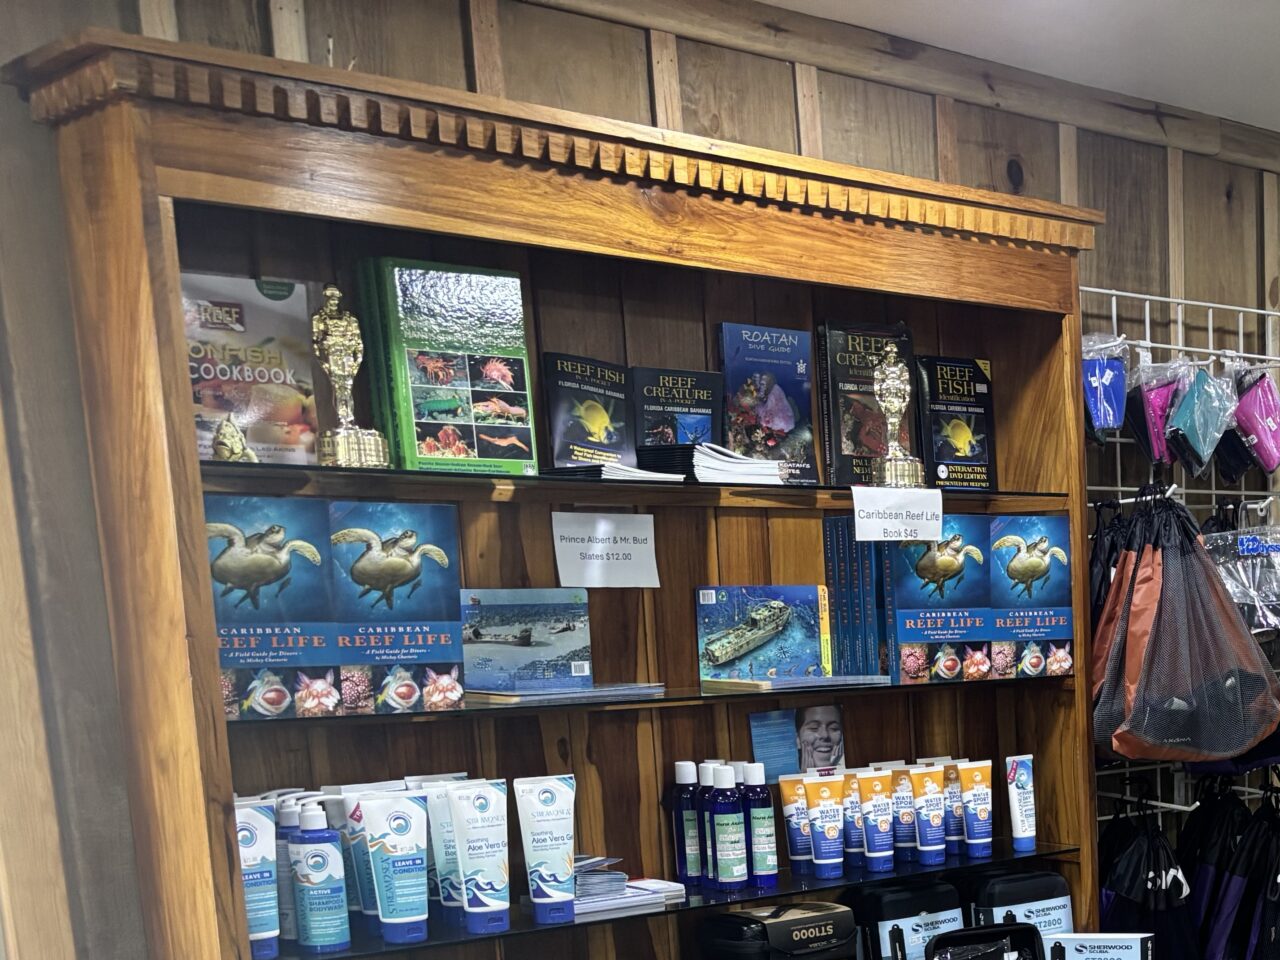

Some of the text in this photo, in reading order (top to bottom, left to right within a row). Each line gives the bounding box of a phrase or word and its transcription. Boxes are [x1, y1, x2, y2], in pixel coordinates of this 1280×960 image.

[741, 330, 799, 347] ROATAN
[188, 342, 285, 366] ONFISH
[188, 362, 298, 385] COOKBOOK
[557, 359, 625, 384] REEF FISH
[937, 365, 974, 381] REEF
[558, 380, 580, 389] FLORIDA
[660, 375, 697, 388] REEF
[838, 382, 858, 391] FLORIDA
[938, 379, 975, 396] FISH
[643, 386, 712, 401] CREATURE
[644, 404, 664, 412] FLORIDA
[948, 465, 987, 474] INTERACTIVE
[949, 471, 987, 480] DVD EDITION
[857, 509, 940, 521] Caribbean Reef Life
[883, 528, 918, 539] Book $45
[559, 535, 648, 545] Prince Albert & Mr. Bud
[605, 552, 632, 561] $12.00
[905, 617, 984, 629] REEF LIFE
[996, 616, 1068, 628] REEF LIFE
[220, 627, 301, 635] CARIBBEAN
[358, 625, 430, 634] CARIBBEAN
[217, 635, 327, 649] EEF LIFE
[337, 633, 452, 647] REEF LIFE
[530, 830, 554, 838] Soothing
[466, 837, 489, 845] Soothing
[531, 835, 565, 845] Aloe Vera
[467, 843, 484, 852] Aloe
[1034, 903, 1068, 914] SHERWOOD
[923, 915, 959, 927] SHERWOOD
[792, 925, 834, 941] ST1000
